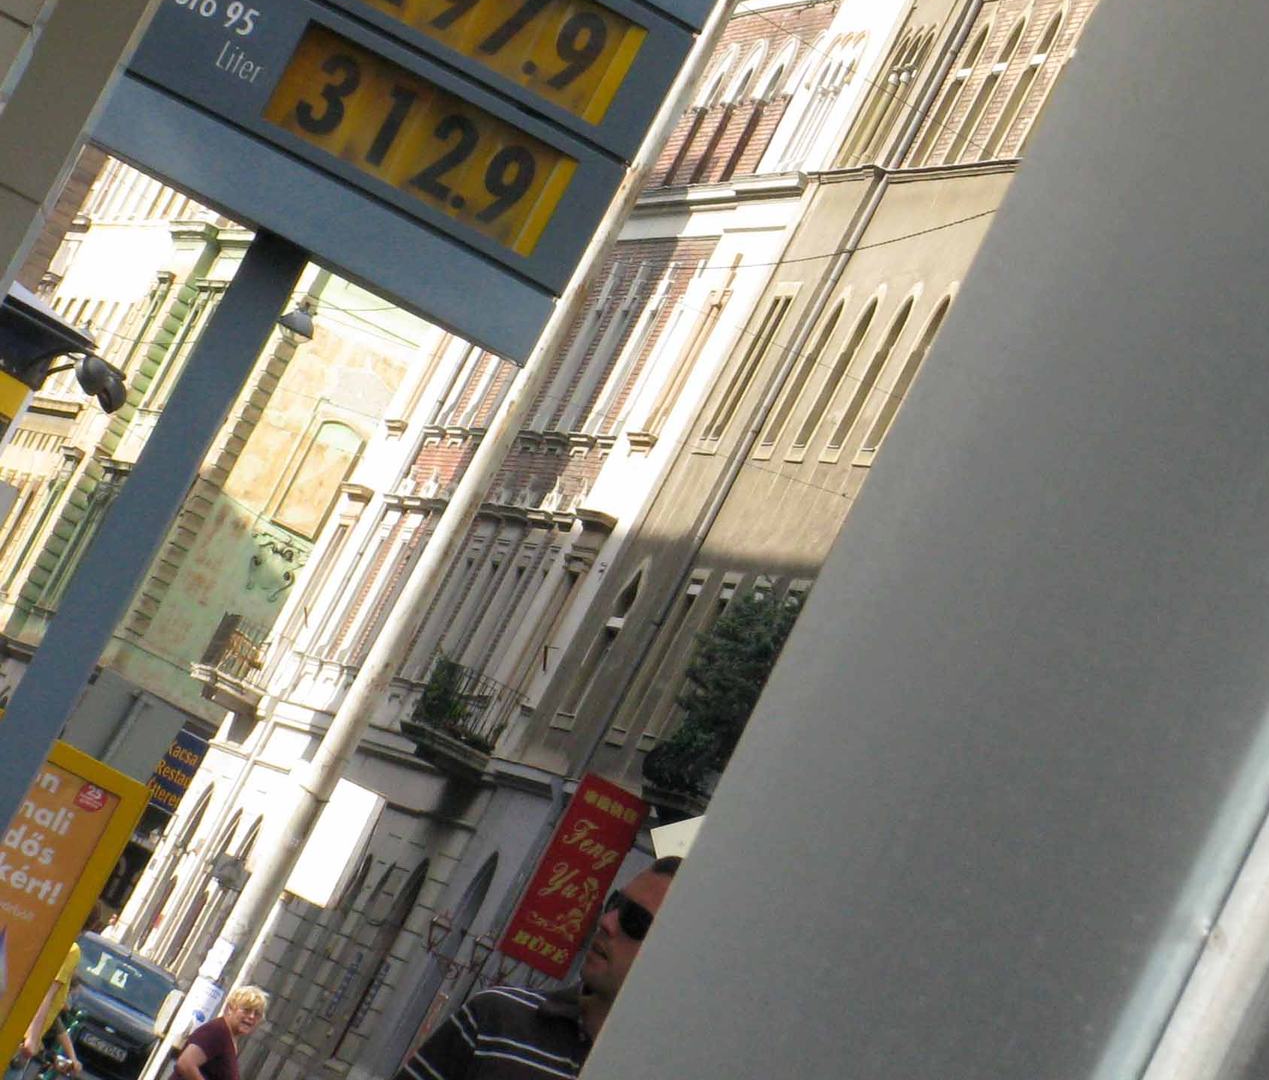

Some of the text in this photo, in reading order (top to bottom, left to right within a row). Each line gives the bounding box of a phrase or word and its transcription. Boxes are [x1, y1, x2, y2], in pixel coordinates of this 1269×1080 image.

[223, 0, 261, 37] 95
[214, 39, 265, 84] Liter
[295, 53, 537, 225] 312.9
